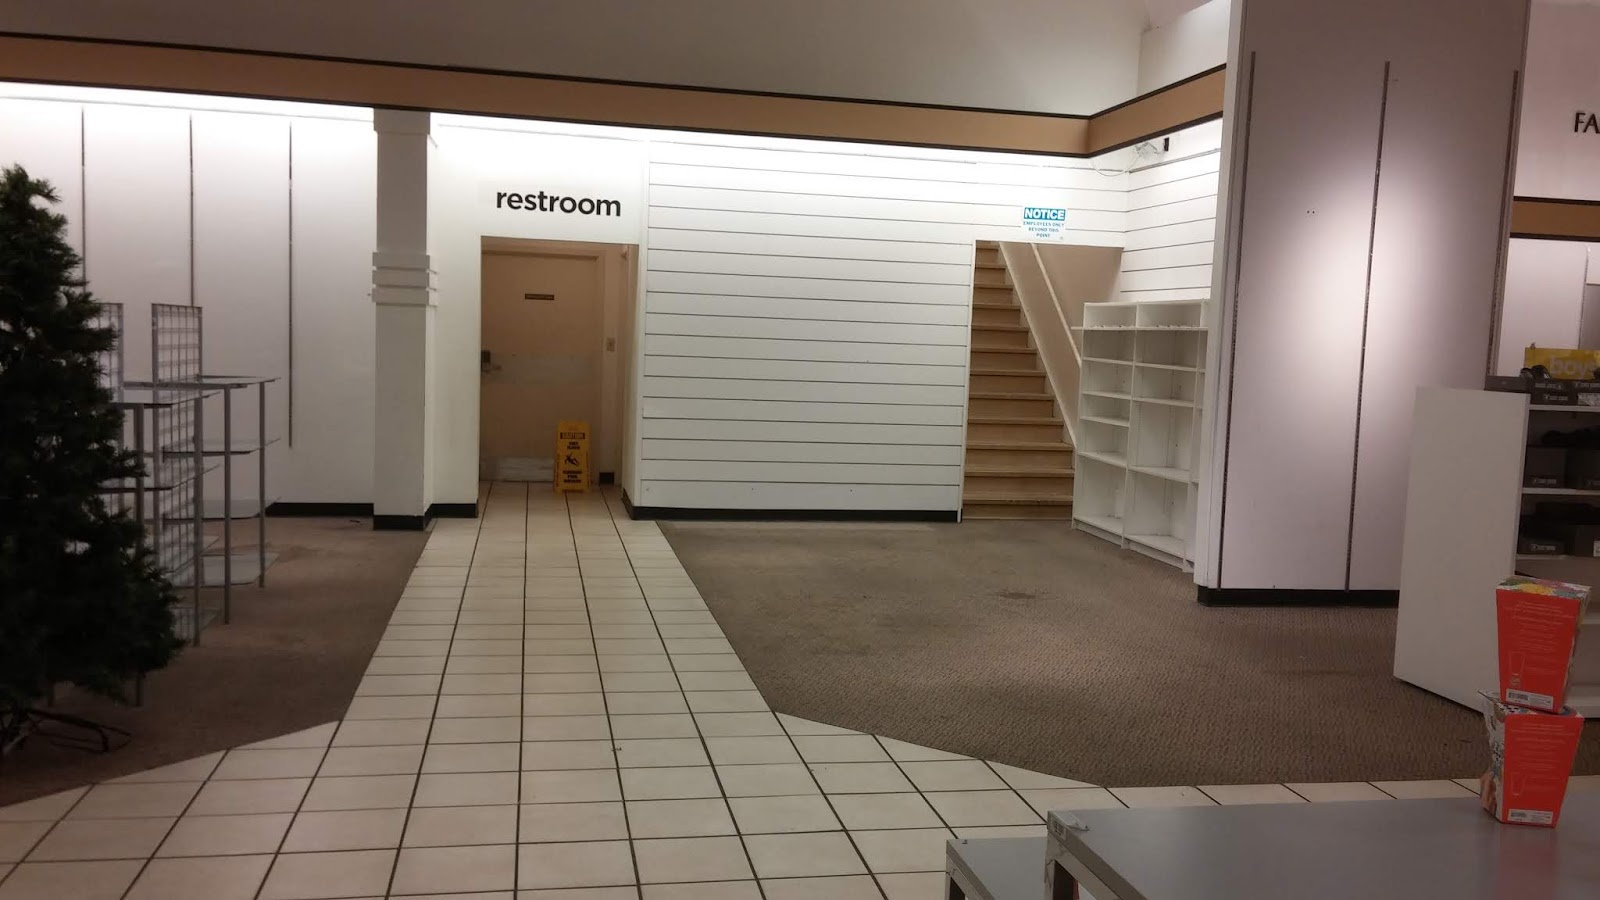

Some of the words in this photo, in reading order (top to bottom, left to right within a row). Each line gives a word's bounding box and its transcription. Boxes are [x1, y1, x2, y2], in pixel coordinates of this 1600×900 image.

[1574, 112, 1600, 134] FA
[497, 191, 621, 217] restroom
[1025, 208, 1064, 220] NOTICE
